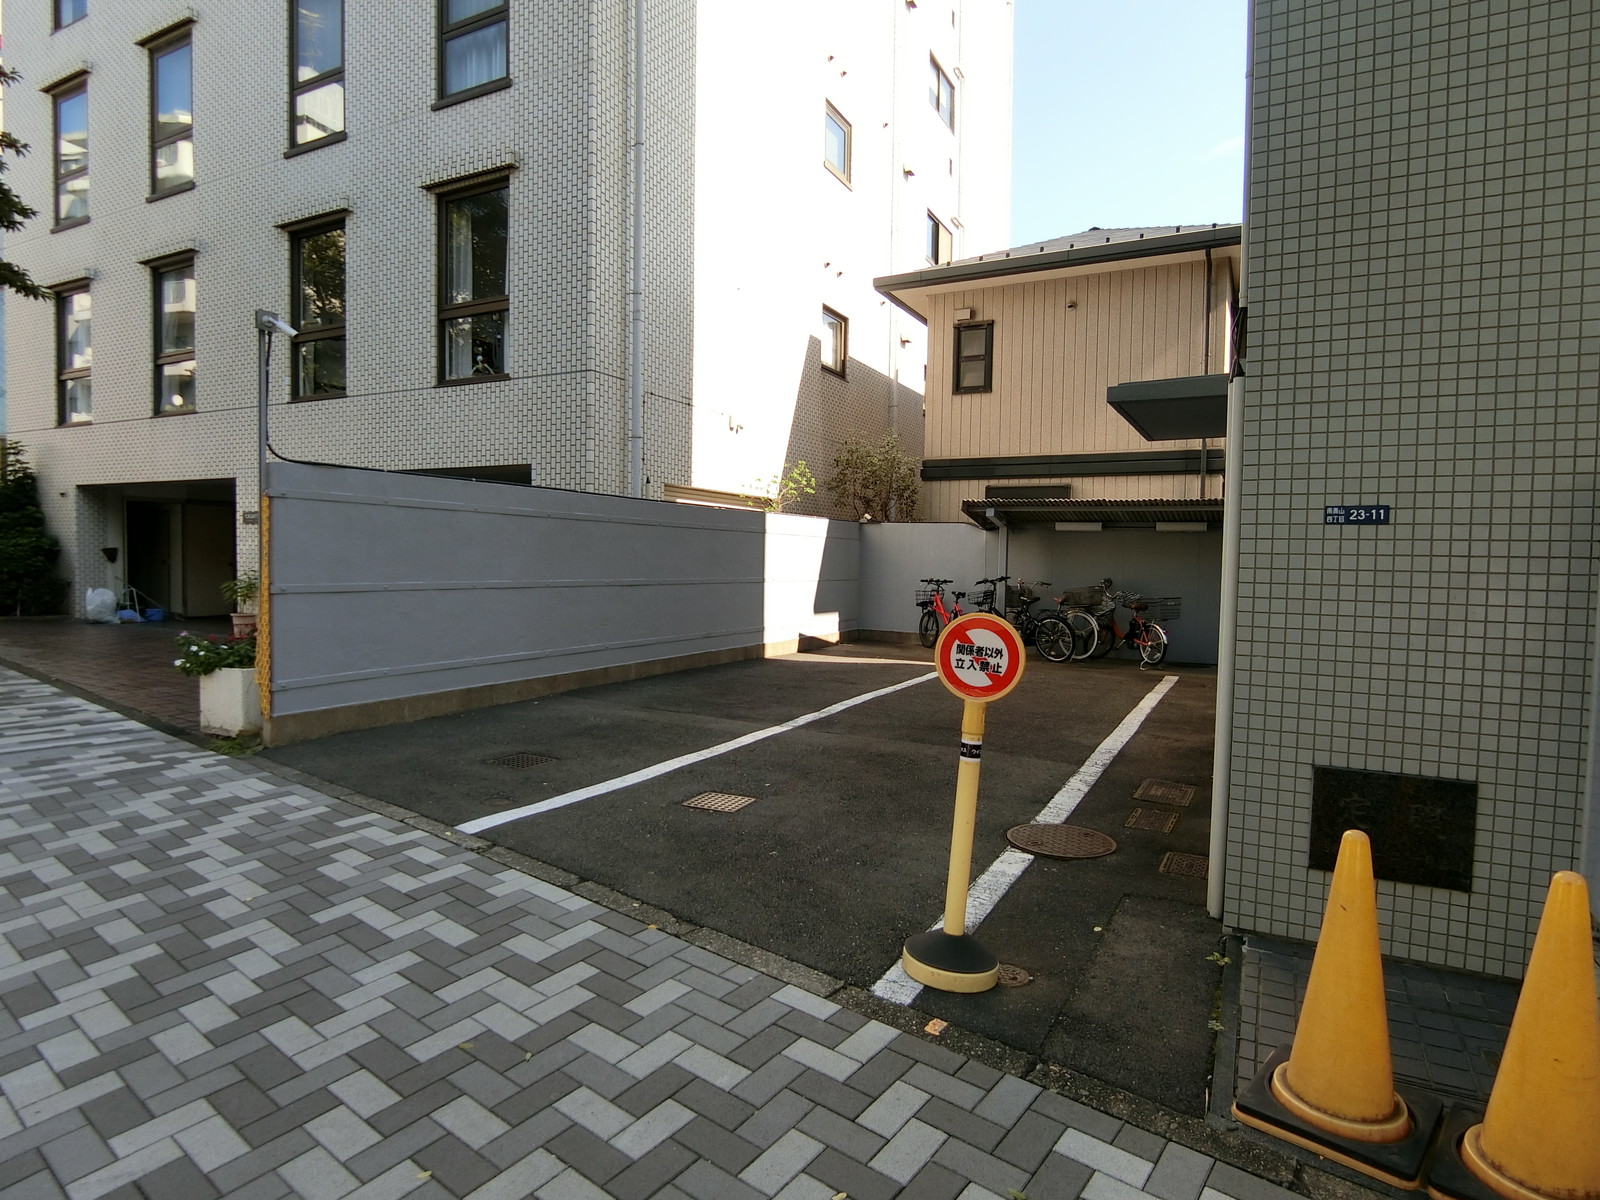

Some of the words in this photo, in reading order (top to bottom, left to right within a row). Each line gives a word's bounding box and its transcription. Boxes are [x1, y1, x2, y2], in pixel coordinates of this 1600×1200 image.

[1326, 515, 1345, 523] 四丁目
[1349, 509, 1384, 520] 23-11
[956, 643, 1004, 660] 関係者以外
[954, 657, 1003, 674] 立入禁止
